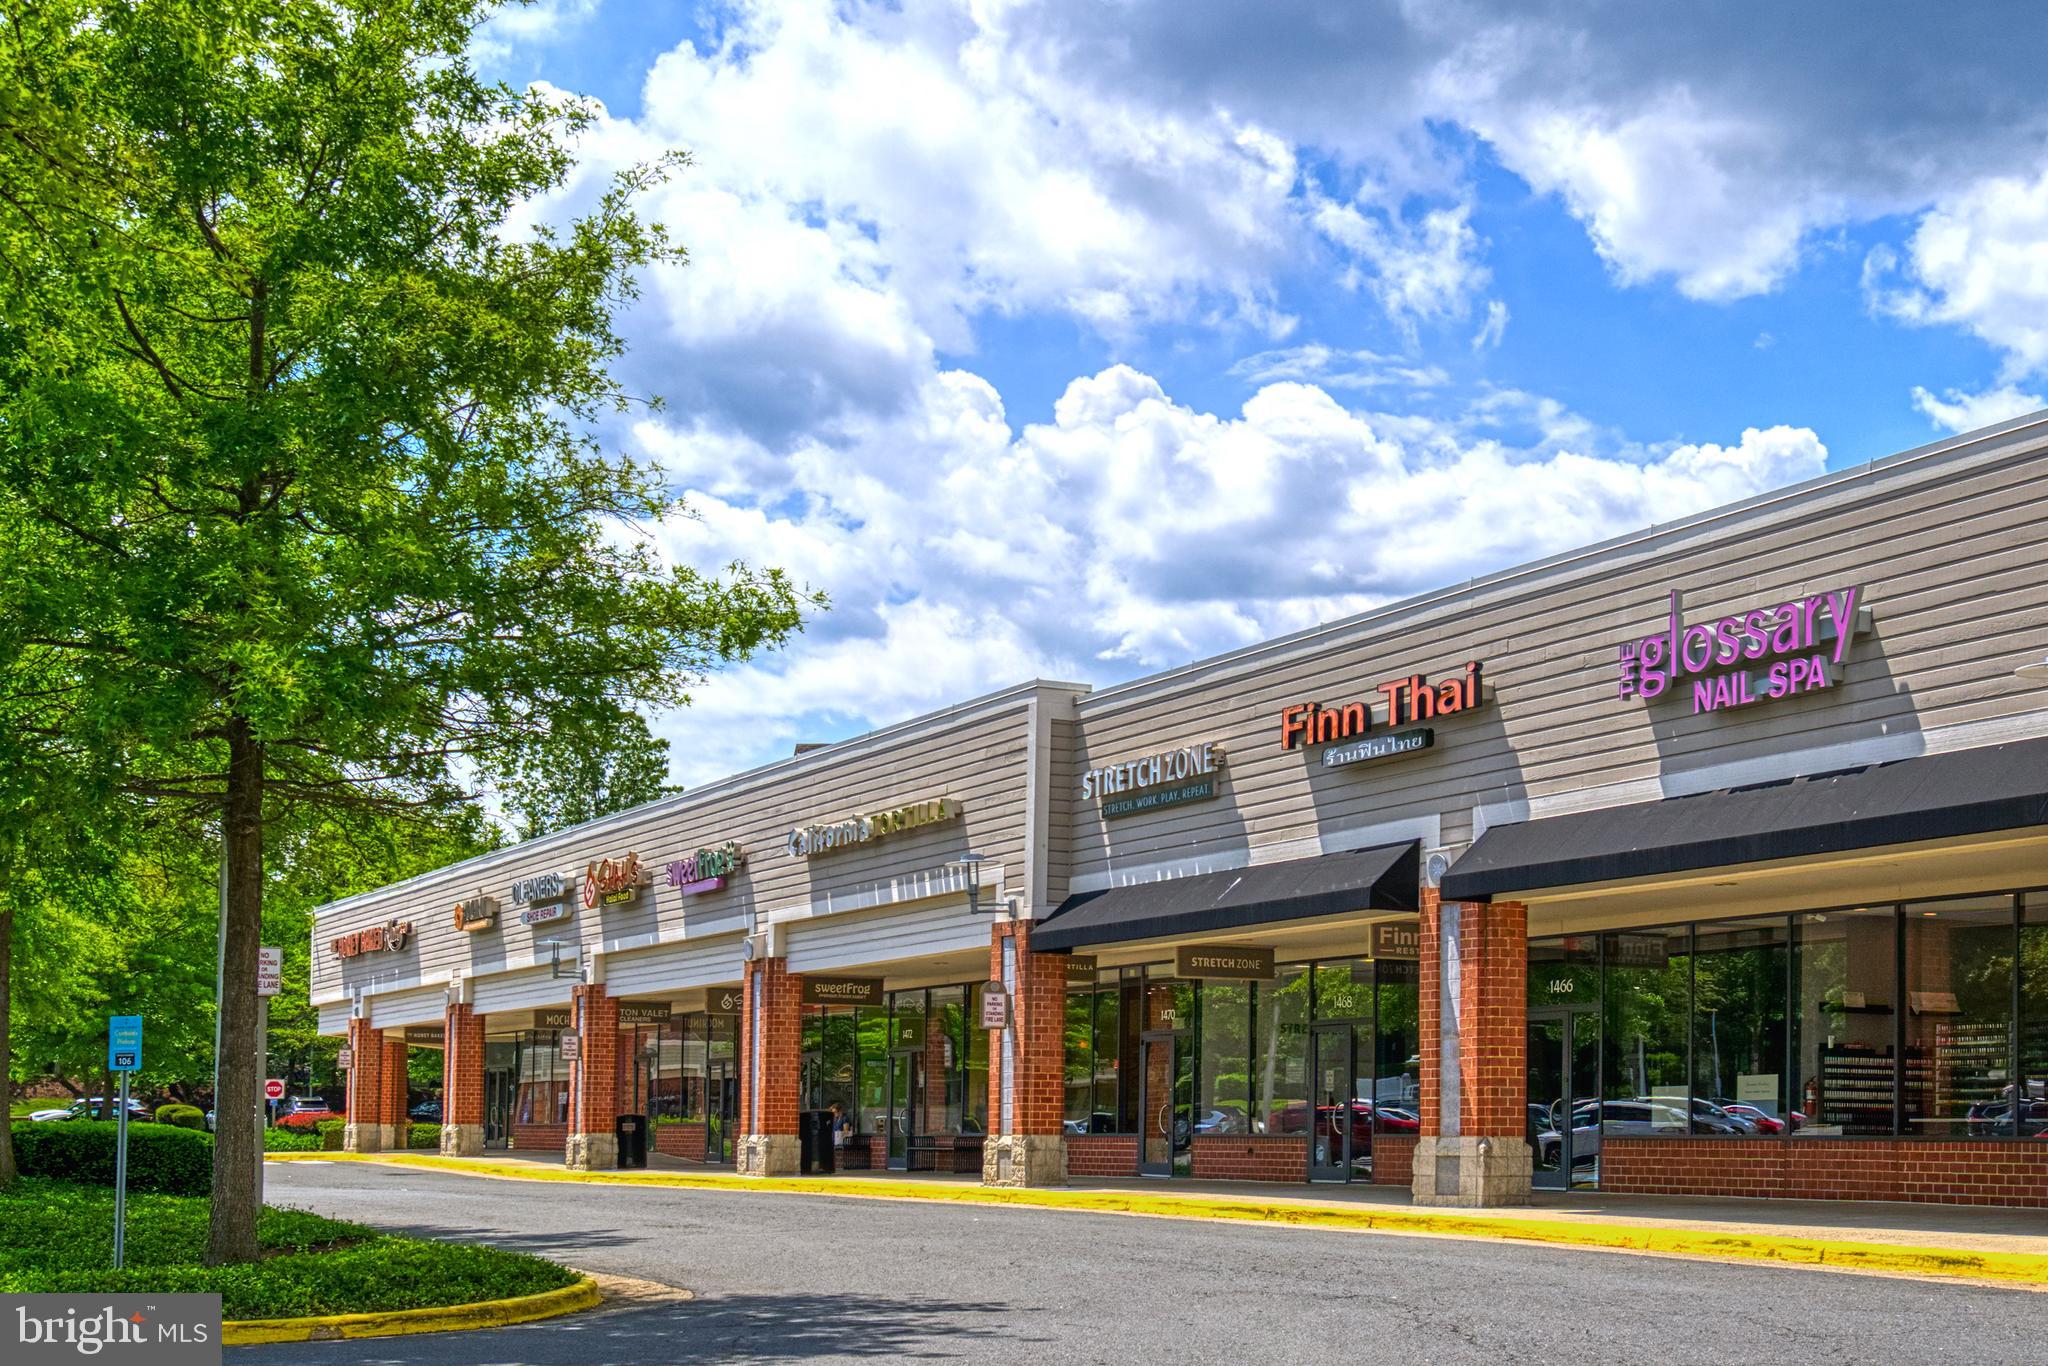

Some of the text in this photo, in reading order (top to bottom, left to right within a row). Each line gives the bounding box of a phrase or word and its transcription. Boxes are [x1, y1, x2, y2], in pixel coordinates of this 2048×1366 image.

[1638, 587, 1860, 698] glossary
[1618, 642, 1636, 700] THE
[1693, 655, 1827, 714] NAIL SPA
[1281, 660, 1481, 750] Finn Thai
[1082, 742, 1213, 800] STRETCH ZONE
[788, 799, 951, 857] California TORTILLA
[512, 872, 562, 907] CLEANERS
[526, 906, 557, 923] SHOE REPAIR
[1191, 957, 1262, 970] STRETCH ZONE
[263, 980, 279, 989] LANE
[814, 982, 871, 996] sweetFrog
[1550, 978, 1574, 994] 1466
[1333, 995, 1353, 1009] 1468
[641, 1009, 669, 1017] VALET
[1160, 1009, 1176, 1021] 1470
[118, 1057, 132, 1065] 106
